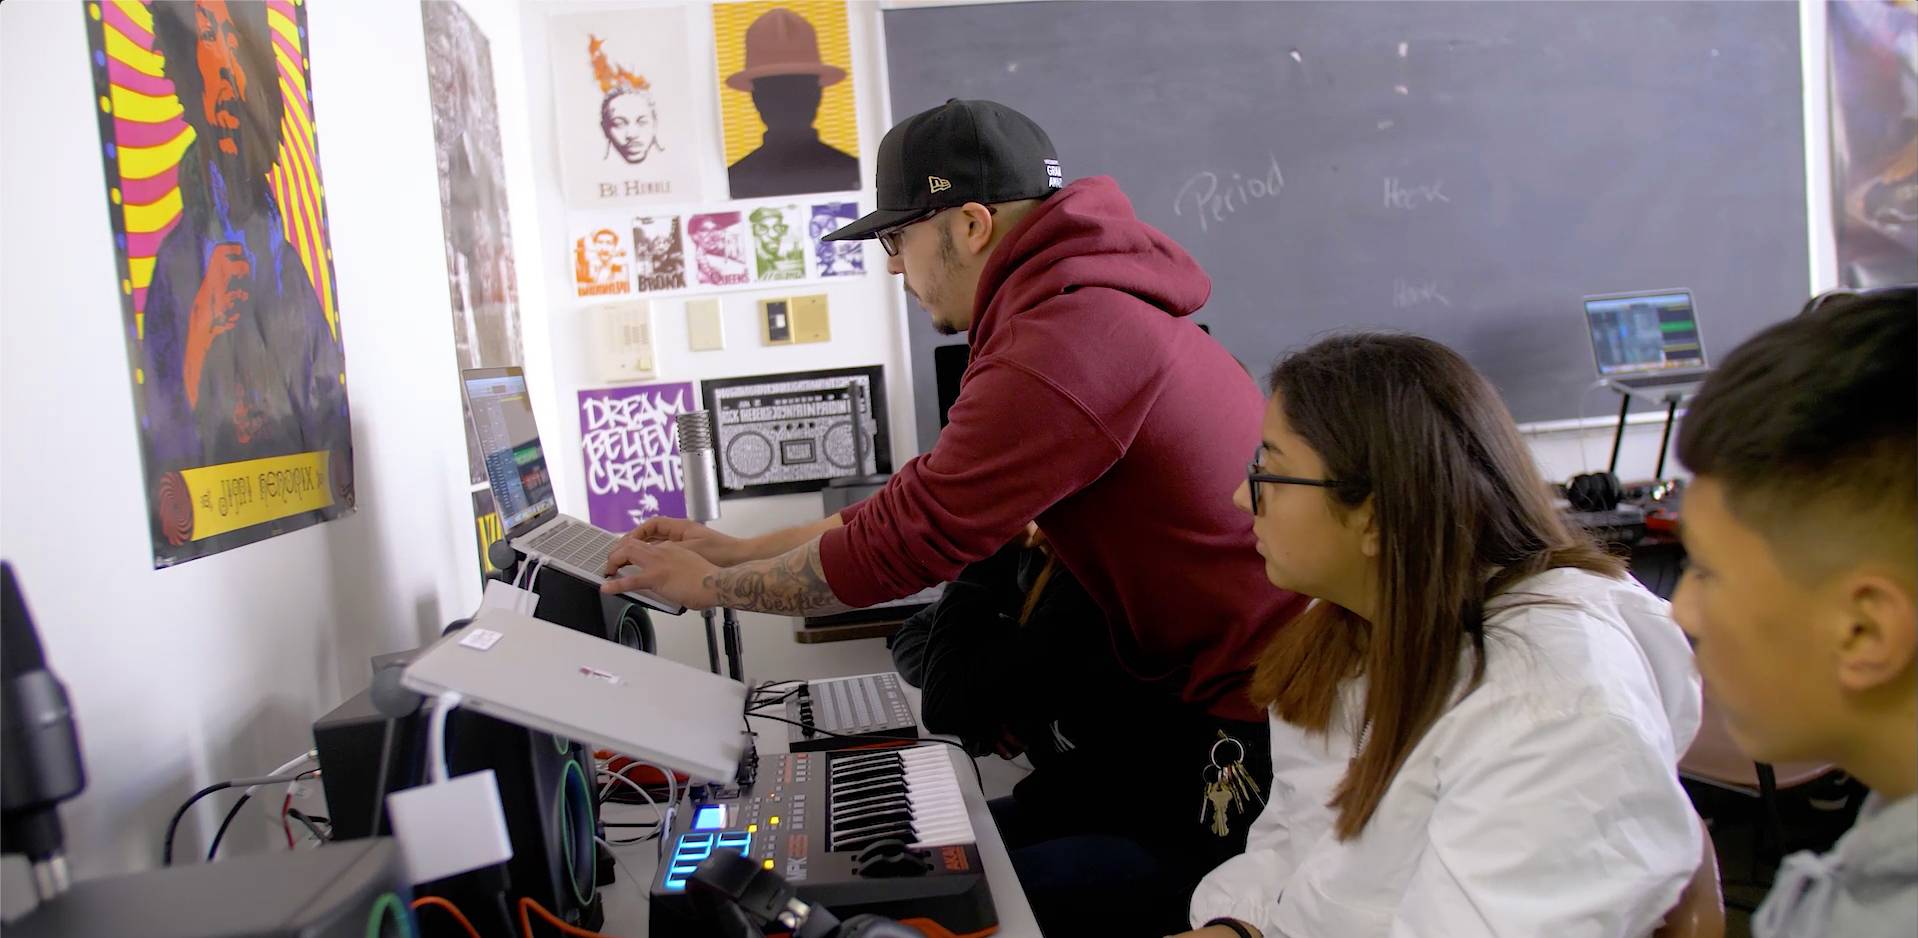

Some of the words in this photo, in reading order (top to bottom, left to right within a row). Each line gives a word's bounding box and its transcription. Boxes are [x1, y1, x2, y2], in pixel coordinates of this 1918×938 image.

[1174, 152, 1285, 232] Period
[638, 274, 687, 292] BRONX
[583, 389, 686, 430] DREAM
[581, 422, 679, 474] BELIEV
[589, 454, 685, 495] CREATE
